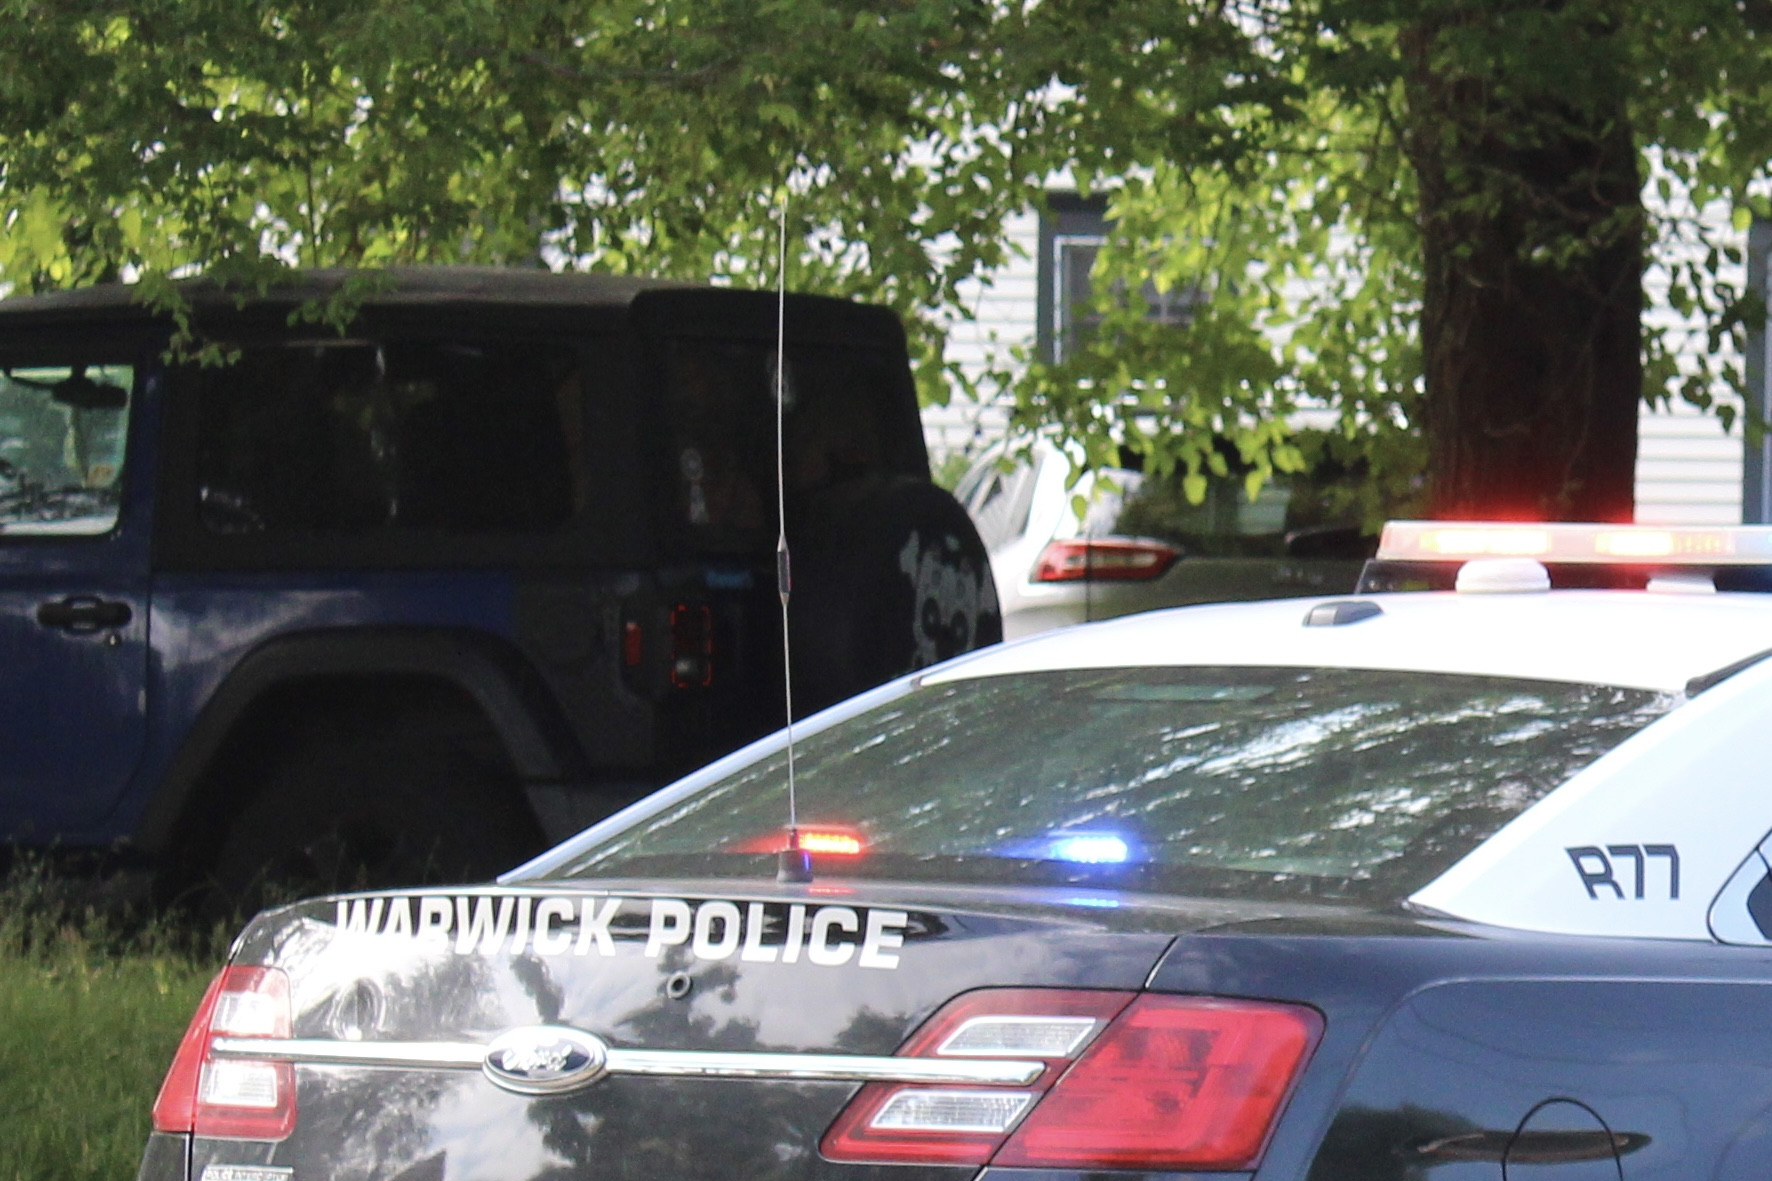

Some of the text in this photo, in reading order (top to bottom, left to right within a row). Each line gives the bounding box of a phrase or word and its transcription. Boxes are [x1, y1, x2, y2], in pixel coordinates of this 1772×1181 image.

[1564, 843, 1680, 901] R77
[336, 896, 908, 969] WARWICK POLICE
